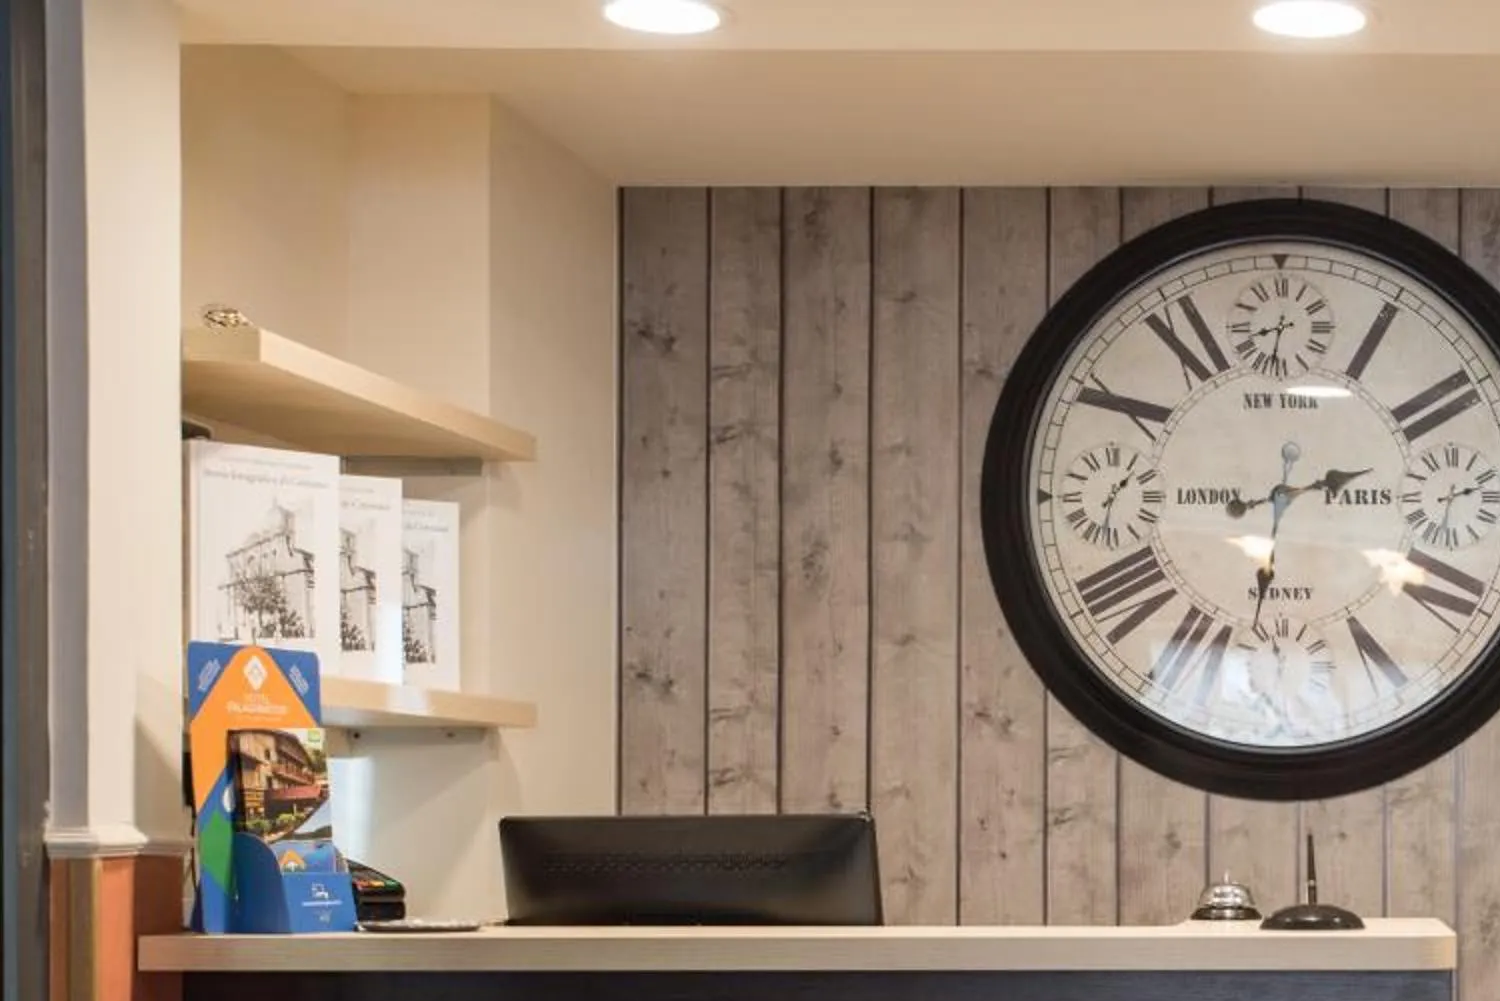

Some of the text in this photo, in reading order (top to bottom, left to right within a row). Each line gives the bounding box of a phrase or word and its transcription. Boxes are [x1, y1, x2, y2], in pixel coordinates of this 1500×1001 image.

[1144, 295, 1231, 391] XI
[1346, 302, 1398, 381] I
[1076, 374, 1174, 442] X
[1243, 393, 1318, 410] NEW YORK
[1391, 370, 1482, 442] II
[1177, 487, 1242, 504] LONDON
[1325, 489, 1391, 505] PARIS
[1075, 546, 1178, 645] VIII
[1248, 587, 1314, 600] SDNEY
[1402, 548, 1485, 634] IV
[1346, 616, 1408, 697] V
